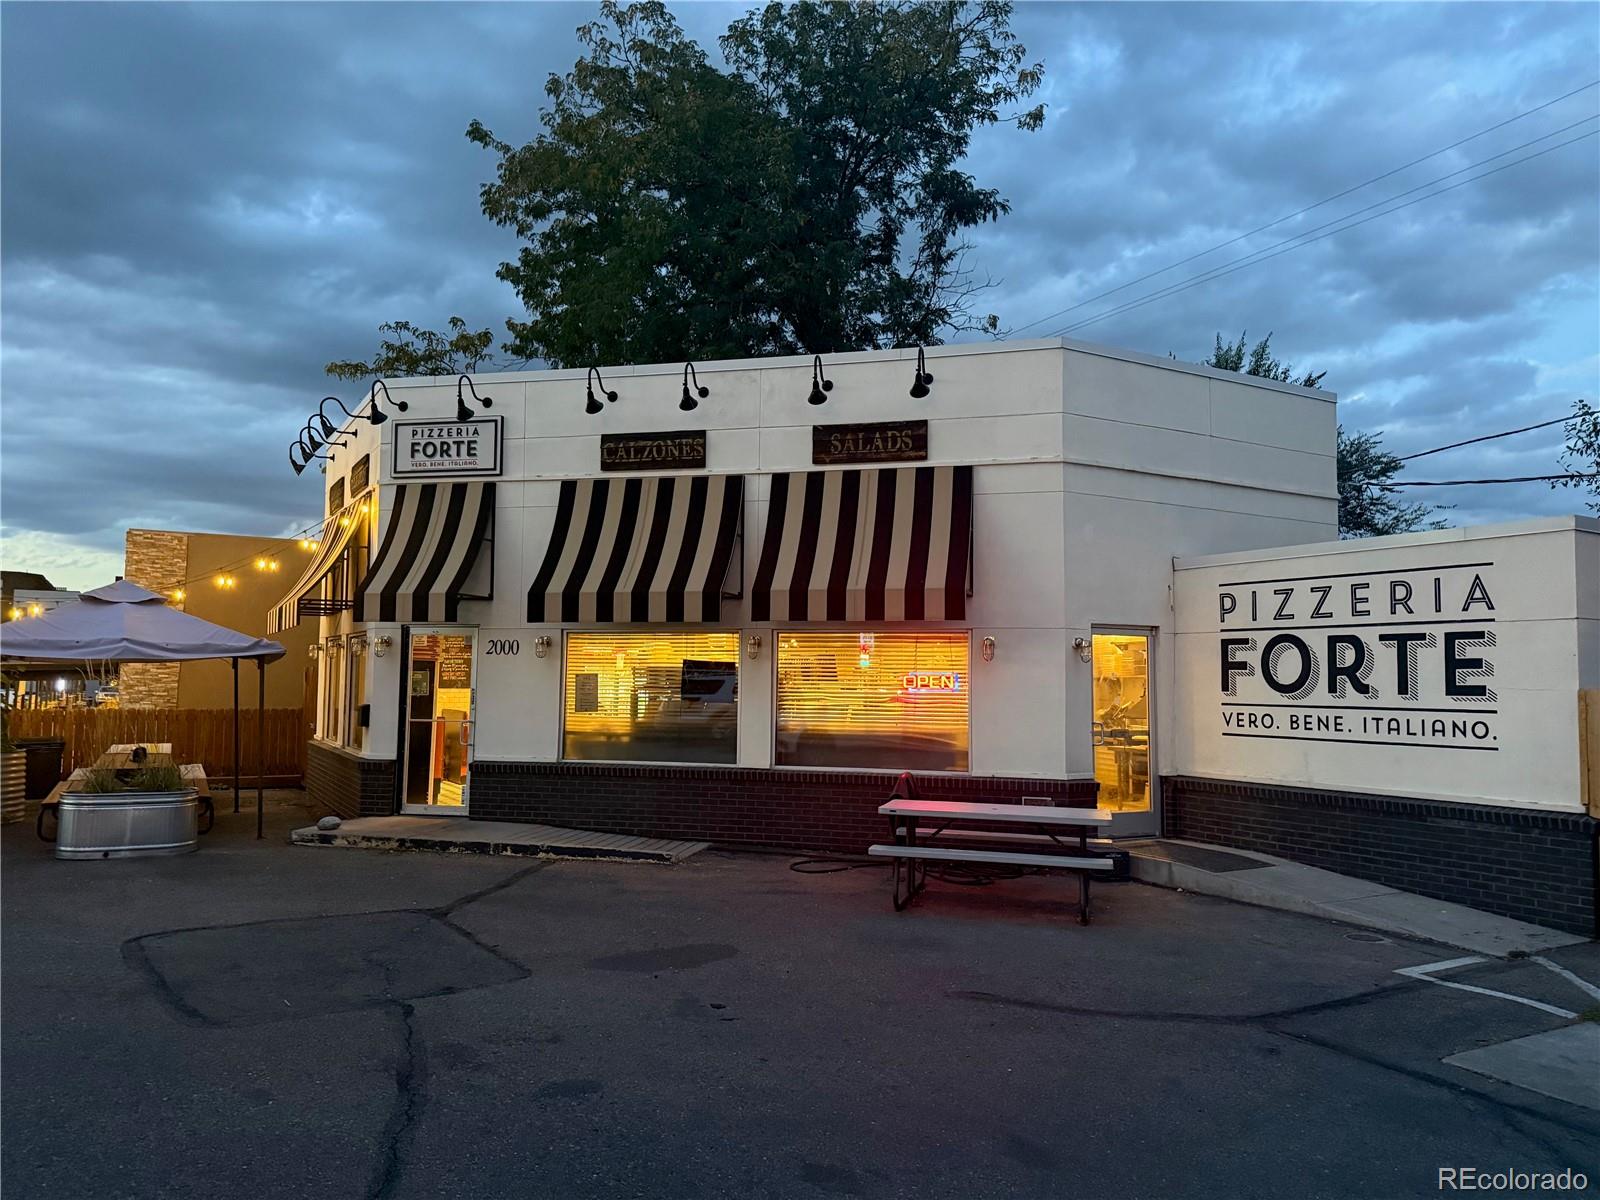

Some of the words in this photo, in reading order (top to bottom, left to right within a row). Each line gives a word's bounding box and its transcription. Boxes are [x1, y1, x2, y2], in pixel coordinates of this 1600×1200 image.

[412, 427, 480, 438] PIZZERIA
[831, 430, 912, 454] SALADS
[410, 440, 478, 459] FORTE
[603, 438, 704, 462] CALZONES
[1219, 573, 1495, 623] PIZZERIA
[486, 639, 520, 656] 2000
[1220, 630, 1498, 702] FORTE
[903, 675, 954, 689] OPEN
[1222, 711, 1281, 730] VERO.
[1289, 714, 1353, 733] BENE.
[1362, 716, 1498, 741] ITALIANO.
